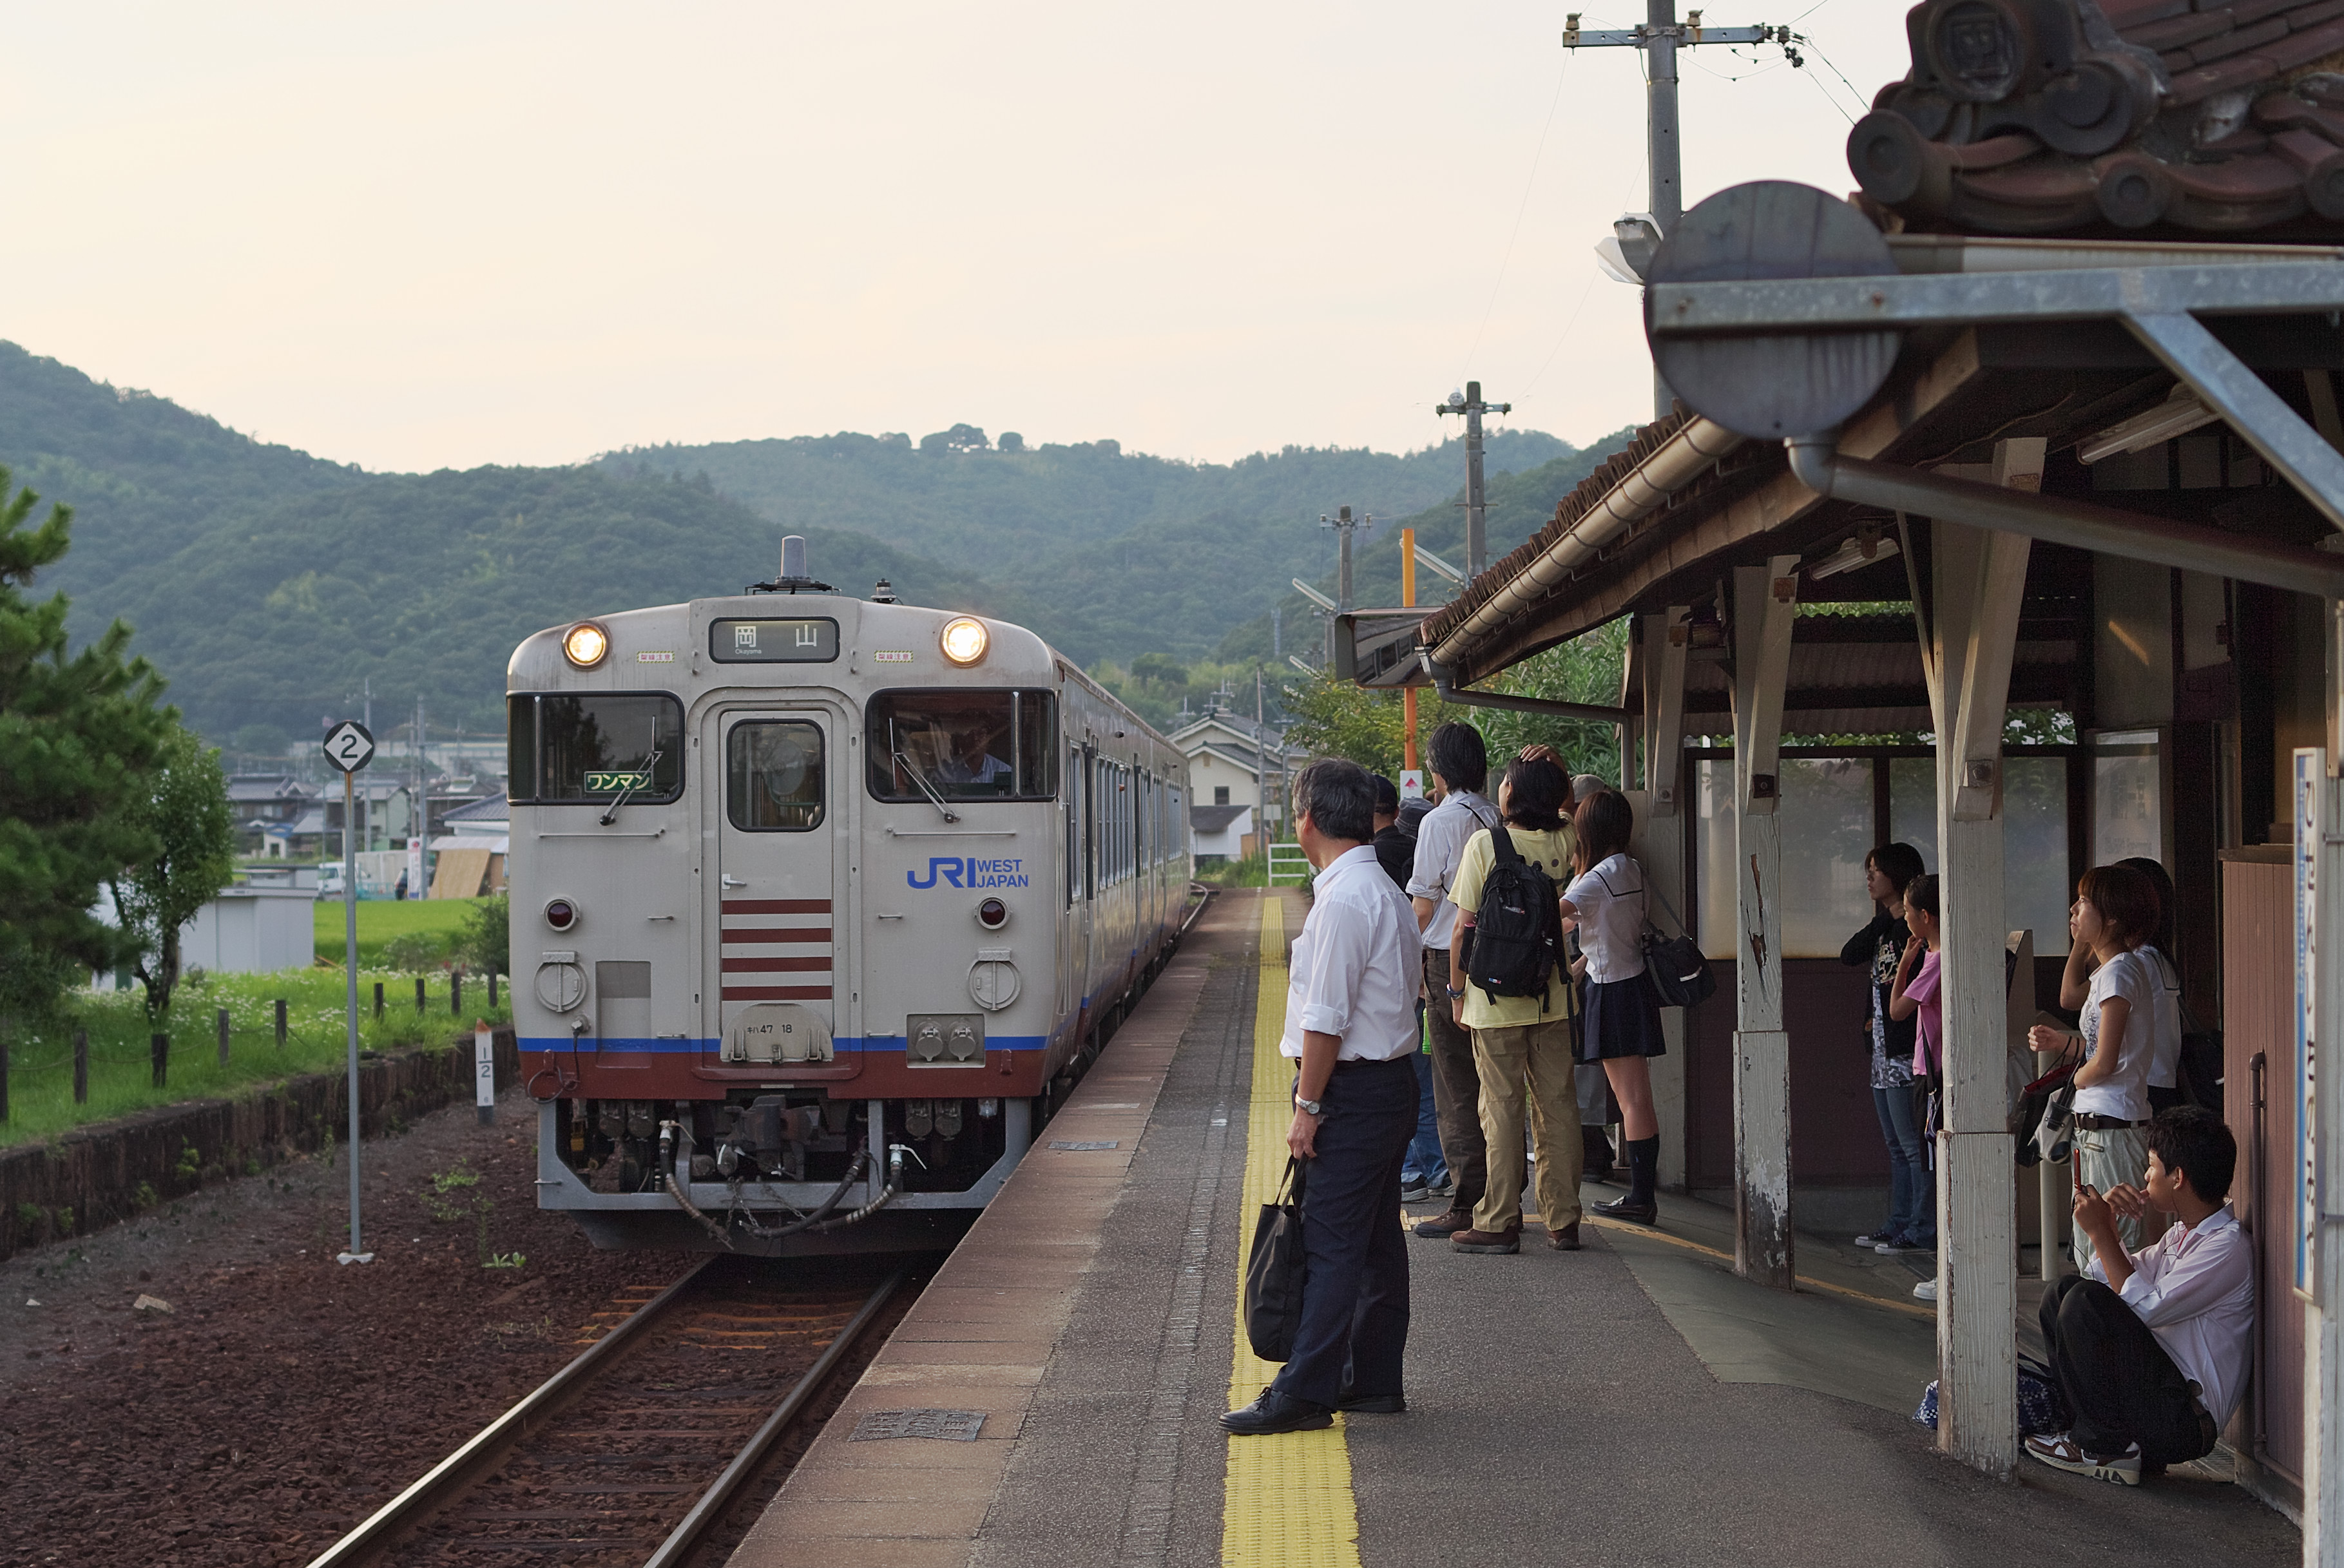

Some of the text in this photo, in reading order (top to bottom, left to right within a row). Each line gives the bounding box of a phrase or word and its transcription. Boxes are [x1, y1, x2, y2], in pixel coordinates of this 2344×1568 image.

[735, 624, 817, 647] 岡山
[340, 734, 358, 758] 2
[587, 774, 650, 790] ワンマン
[977, 859, 1023, 872] WEST
[977, 875, 1028, 888] JAPAN
[782, 1024, 793, 1033] 18
